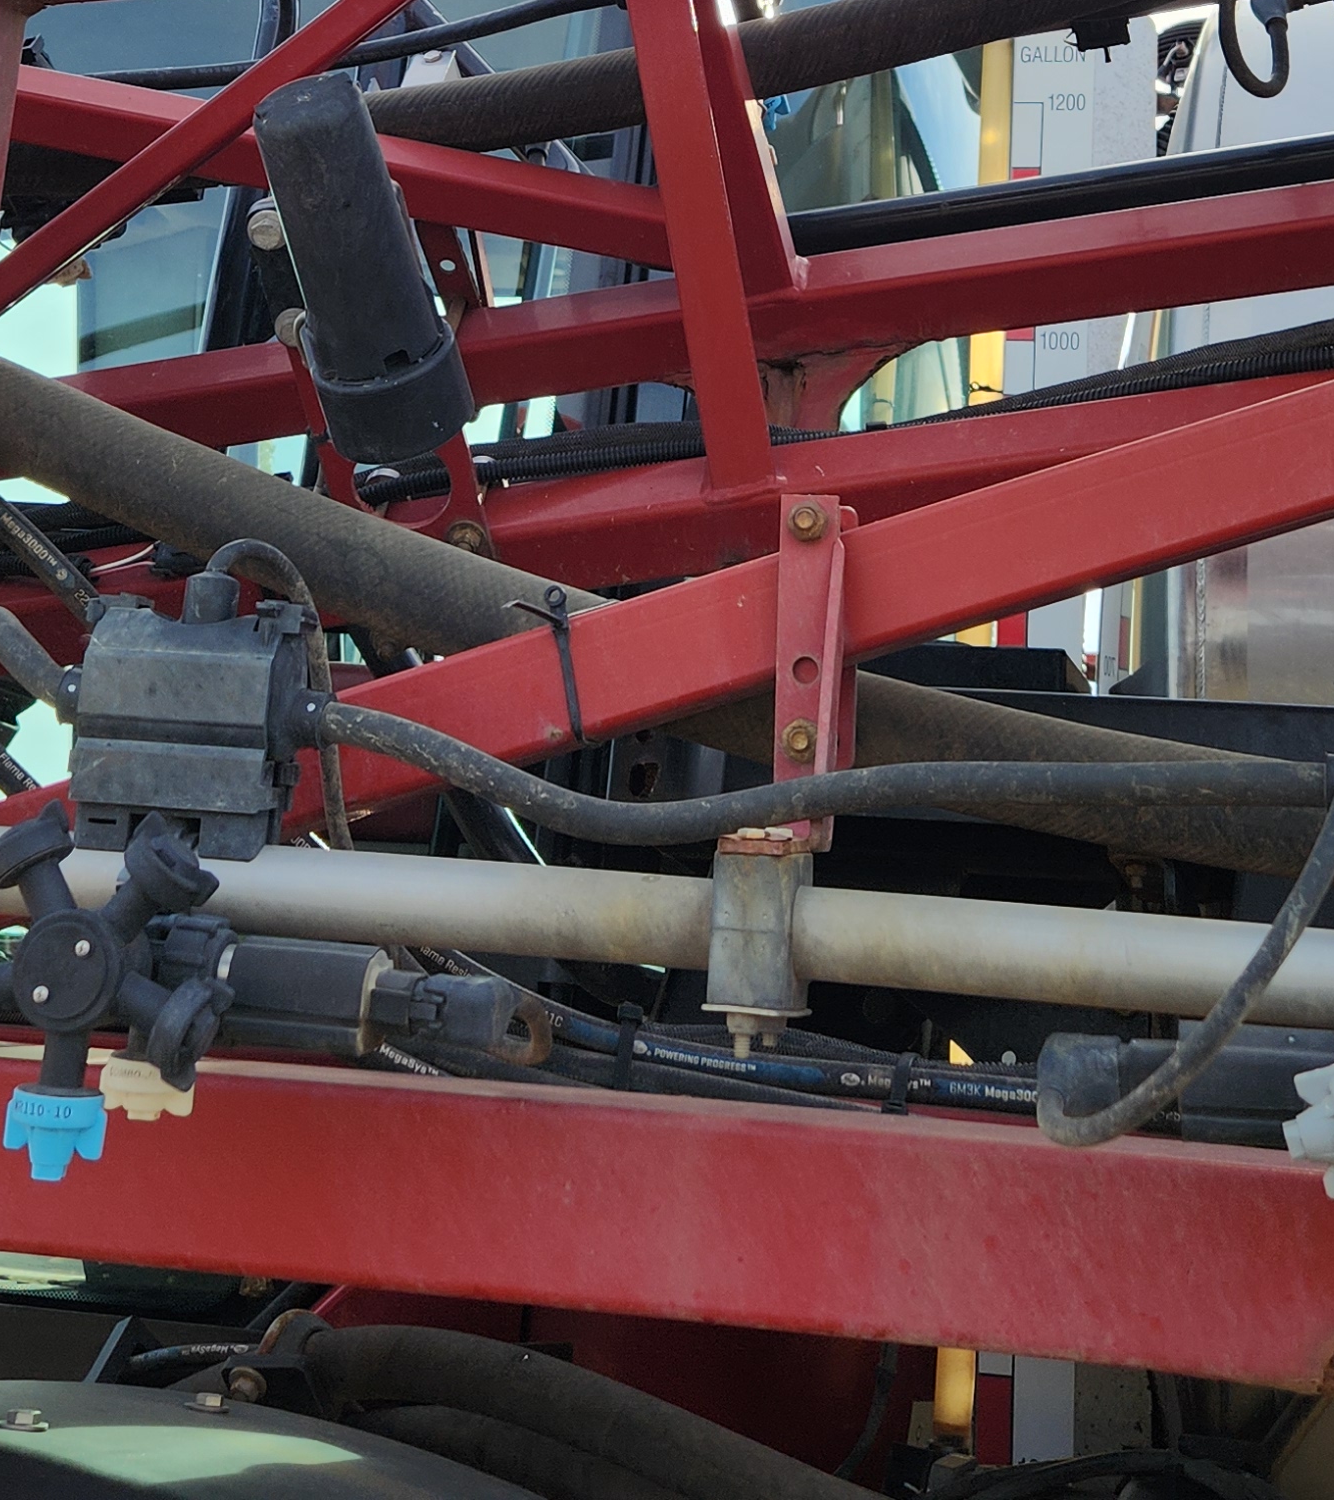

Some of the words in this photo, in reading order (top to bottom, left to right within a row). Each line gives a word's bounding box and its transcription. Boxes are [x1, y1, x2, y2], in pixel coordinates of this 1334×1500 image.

[1020, 45, 1086, 63] GALLON
[1048, 93, 1086, 111] 1200
[1040, 331, 1080, 350] 1000
[22, 777, 37, 792] Re
[419, 946, 445, 967] lame
[654, 1047, 700, 1066] POWERING
[984, 1086, 1039, 1103] Mega300
